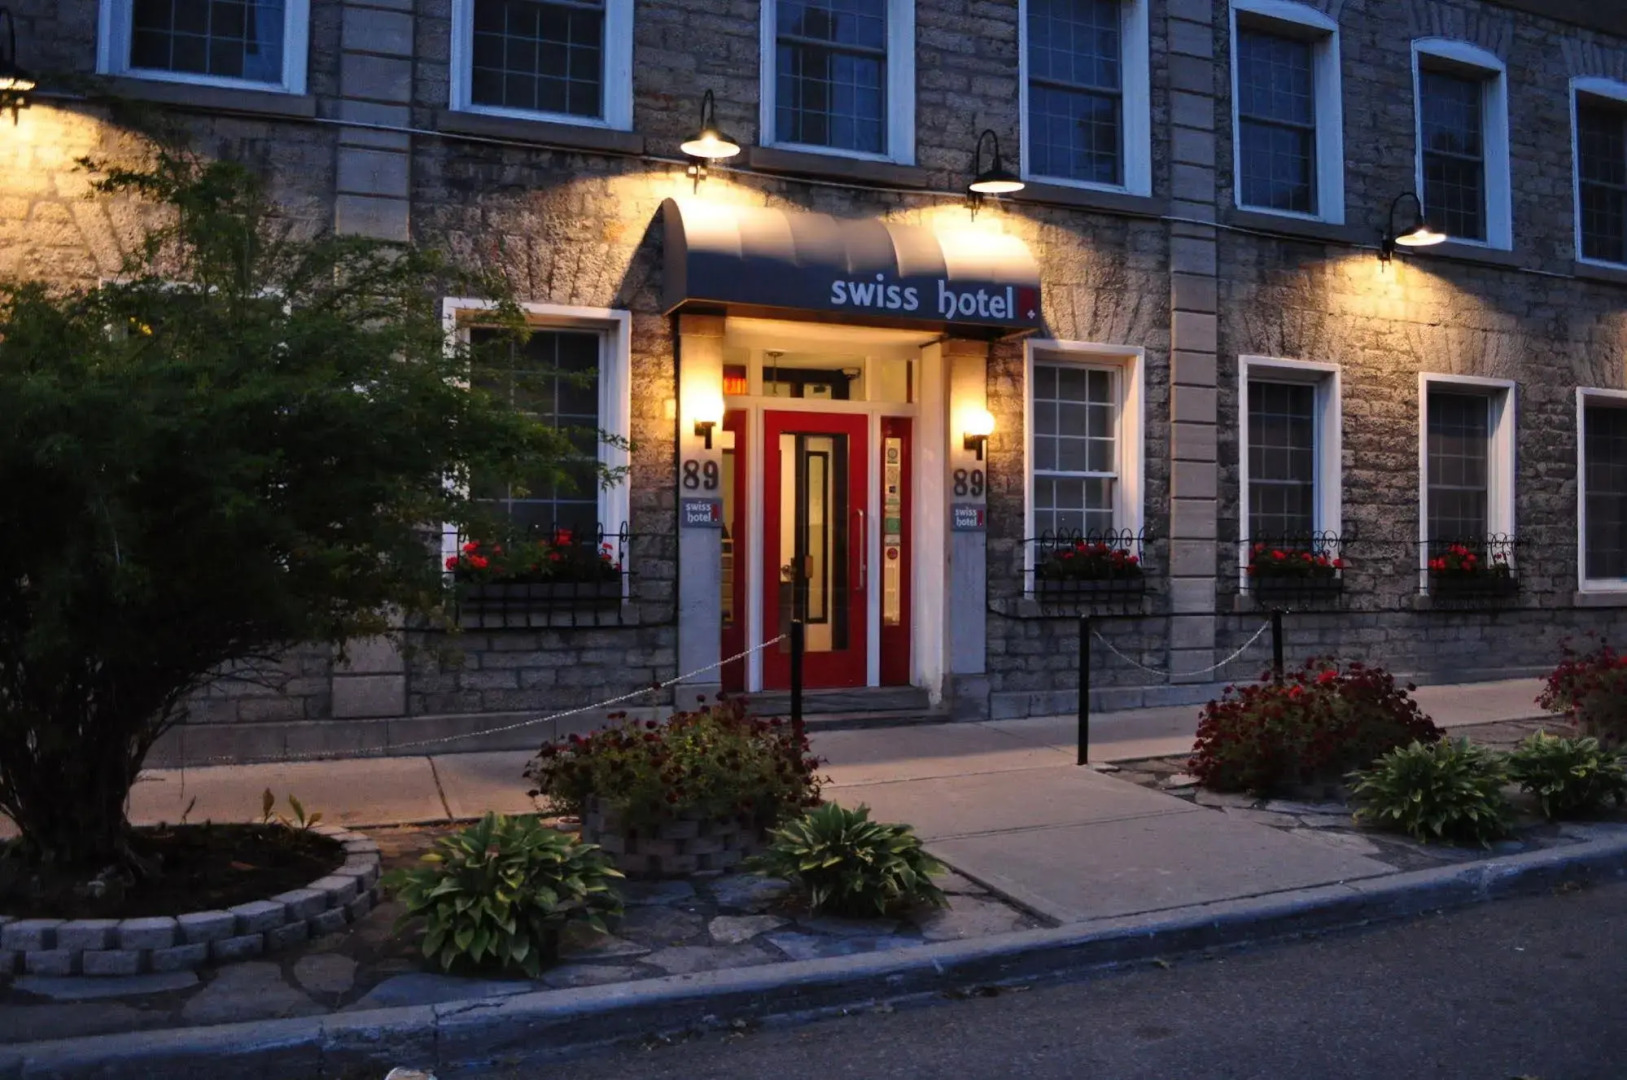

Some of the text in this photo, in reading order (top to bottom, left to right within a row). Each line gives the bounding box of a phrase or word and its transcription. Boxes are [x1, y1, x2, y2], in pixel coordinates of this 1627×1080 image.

[830, 273, 1014, 320] swiss hotel
[683, 459, 719, 491] 89
[953, 468, 984, 498] 89
[685, 500, 712, 511] swiss
[955, 505, 977, 517] swiss
[687, 511, 712, 524] hotel
[956, 516, 978, 527] hotel
